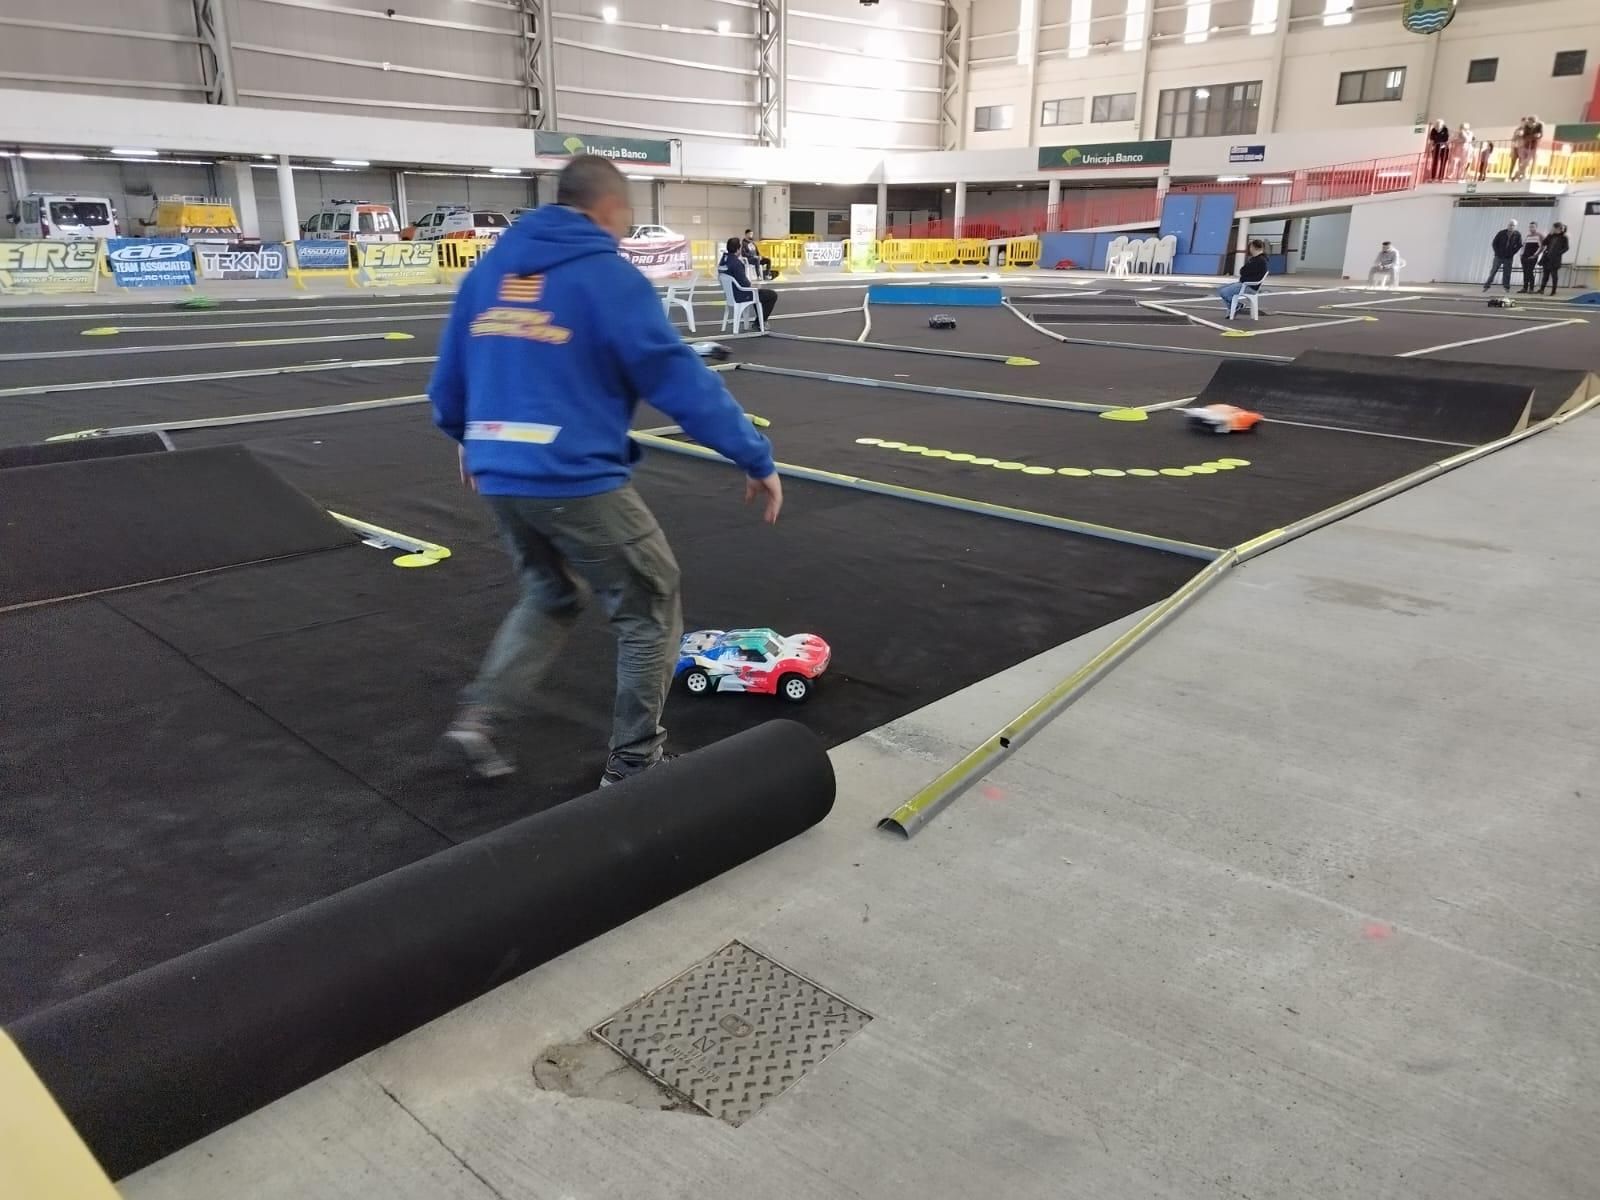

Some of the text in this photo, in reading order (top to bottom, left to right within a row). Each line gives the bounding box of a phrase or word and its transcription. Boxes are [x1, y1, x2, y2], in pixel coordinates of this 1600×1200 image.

[586, 145, 648, 160] Unicaja Banco
[1082, 152, 1143, 165] Unicaja Banco
[631, 252, 688, 264] PRO STYLE
[805, 247, 843, 261] TEKNO
[114, 260, 191, 273] TEAM ASSOCIATED
[201, 251, 282, 272] TEKNO
[122, 273, 190, 282] www.RC10.com
